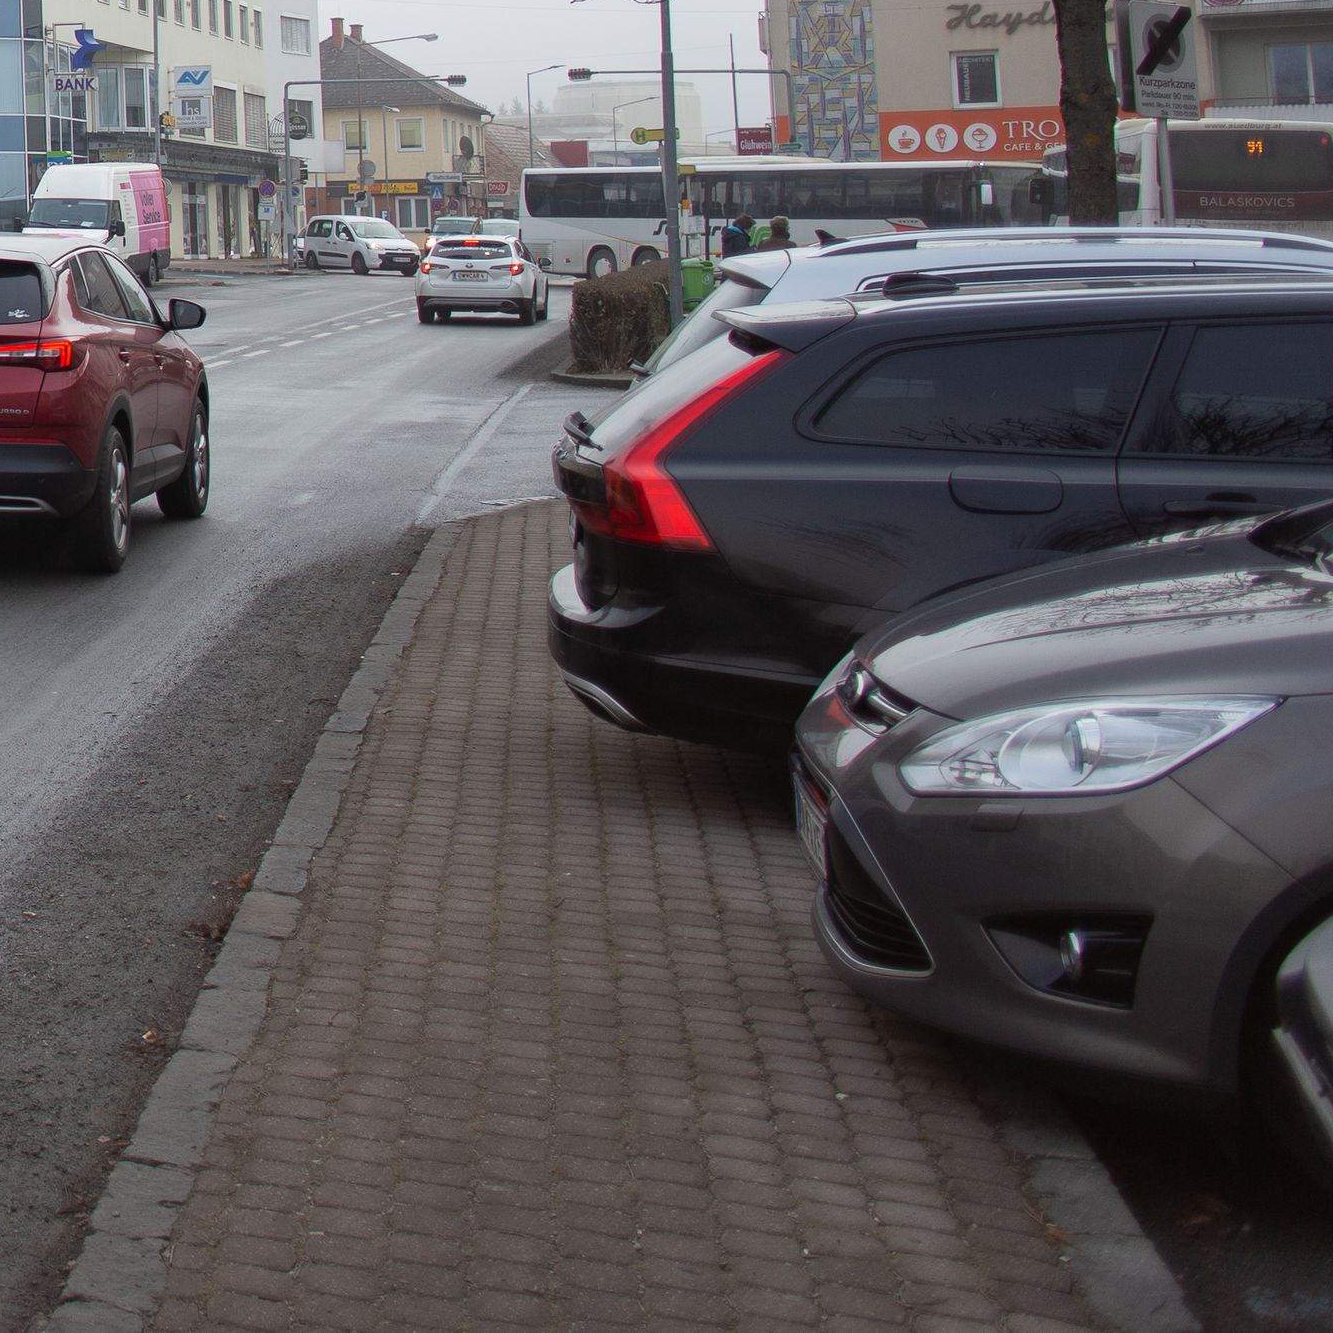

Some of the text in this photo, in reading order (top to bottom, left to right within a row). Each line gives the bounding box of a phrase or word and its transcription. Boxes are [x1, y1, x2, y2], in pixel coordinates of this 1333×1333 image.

[946, 1, 1057, 35] Hayd
[55, 77, 95, 91] BANK
[1139, 76, 1196, 89] Kurzparkzone
[1141, 90, 1172, 100] Parkdauer
[1173, 92, 1182, 100] 90
[185, 101, 200, 116] hs
[1002, 119, 1066, 141] TRO
[1204, 122, 1282, 130] www.suedburg.at
[635, 130, 646, 142] H
[740, 139, 772, 150] Glühwein
[1003, 143, 1032, 152] CAFE
[1034, 142, 1042, 151] &
[1199, 196, 1295, 208] BALASKOVICS
[142, 209, 161, 224] Service
